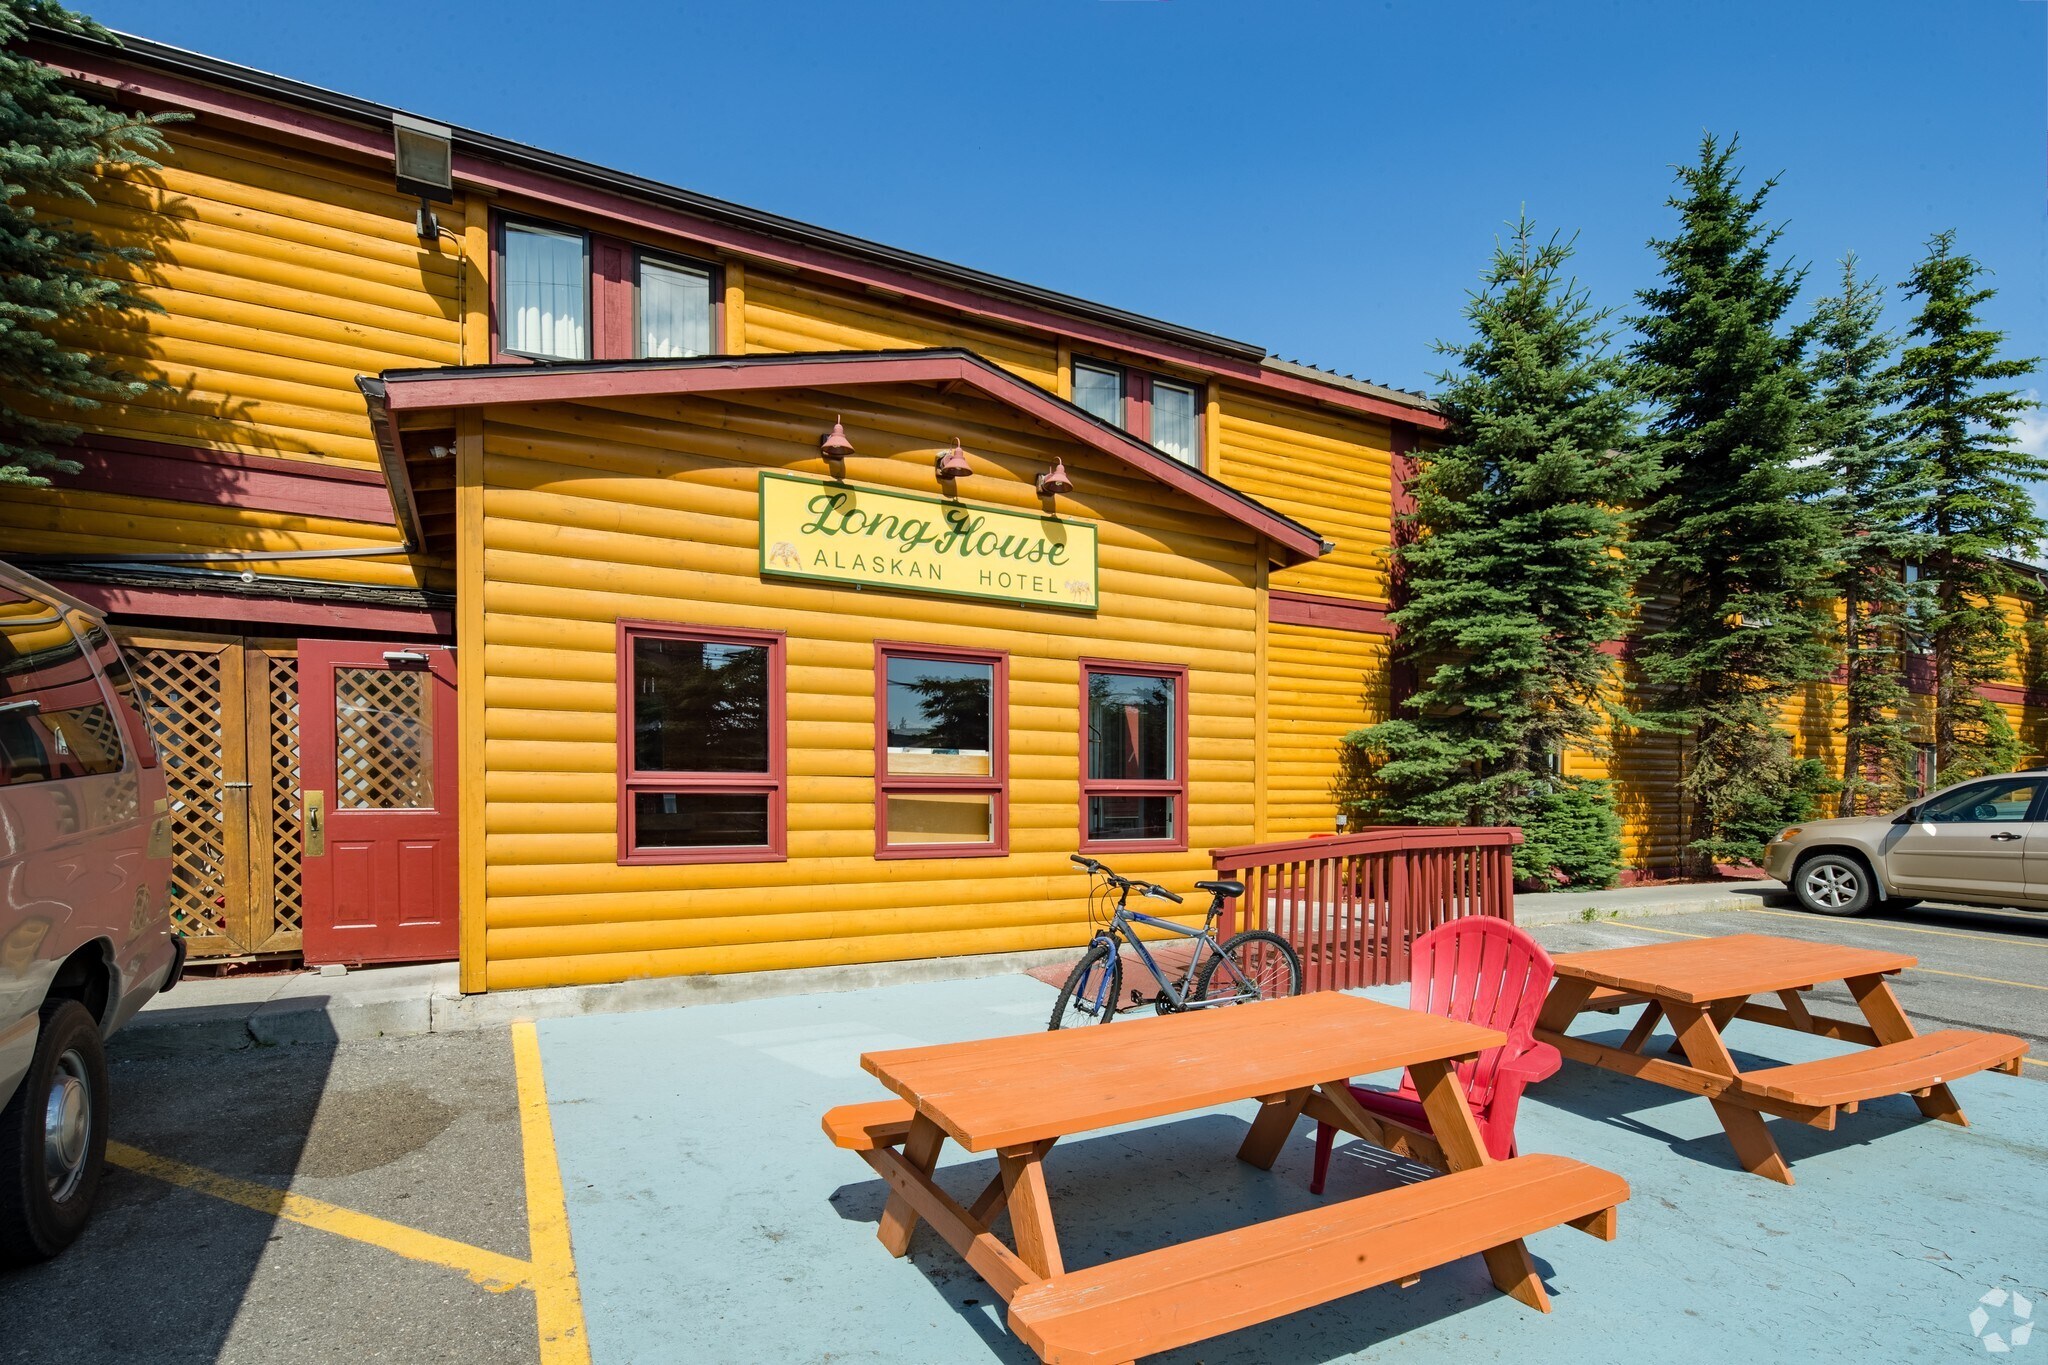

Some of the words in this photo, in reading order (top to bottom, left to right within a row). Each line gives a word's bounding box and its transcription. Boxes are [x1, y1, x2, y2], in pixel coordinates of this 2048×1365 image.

[801, 492, 939, 554] Long
[934, 510, 1070, 566] House
[813, 549, 942, 581] ALASKAN
[979, 569, 1058, 594] HOTEL
